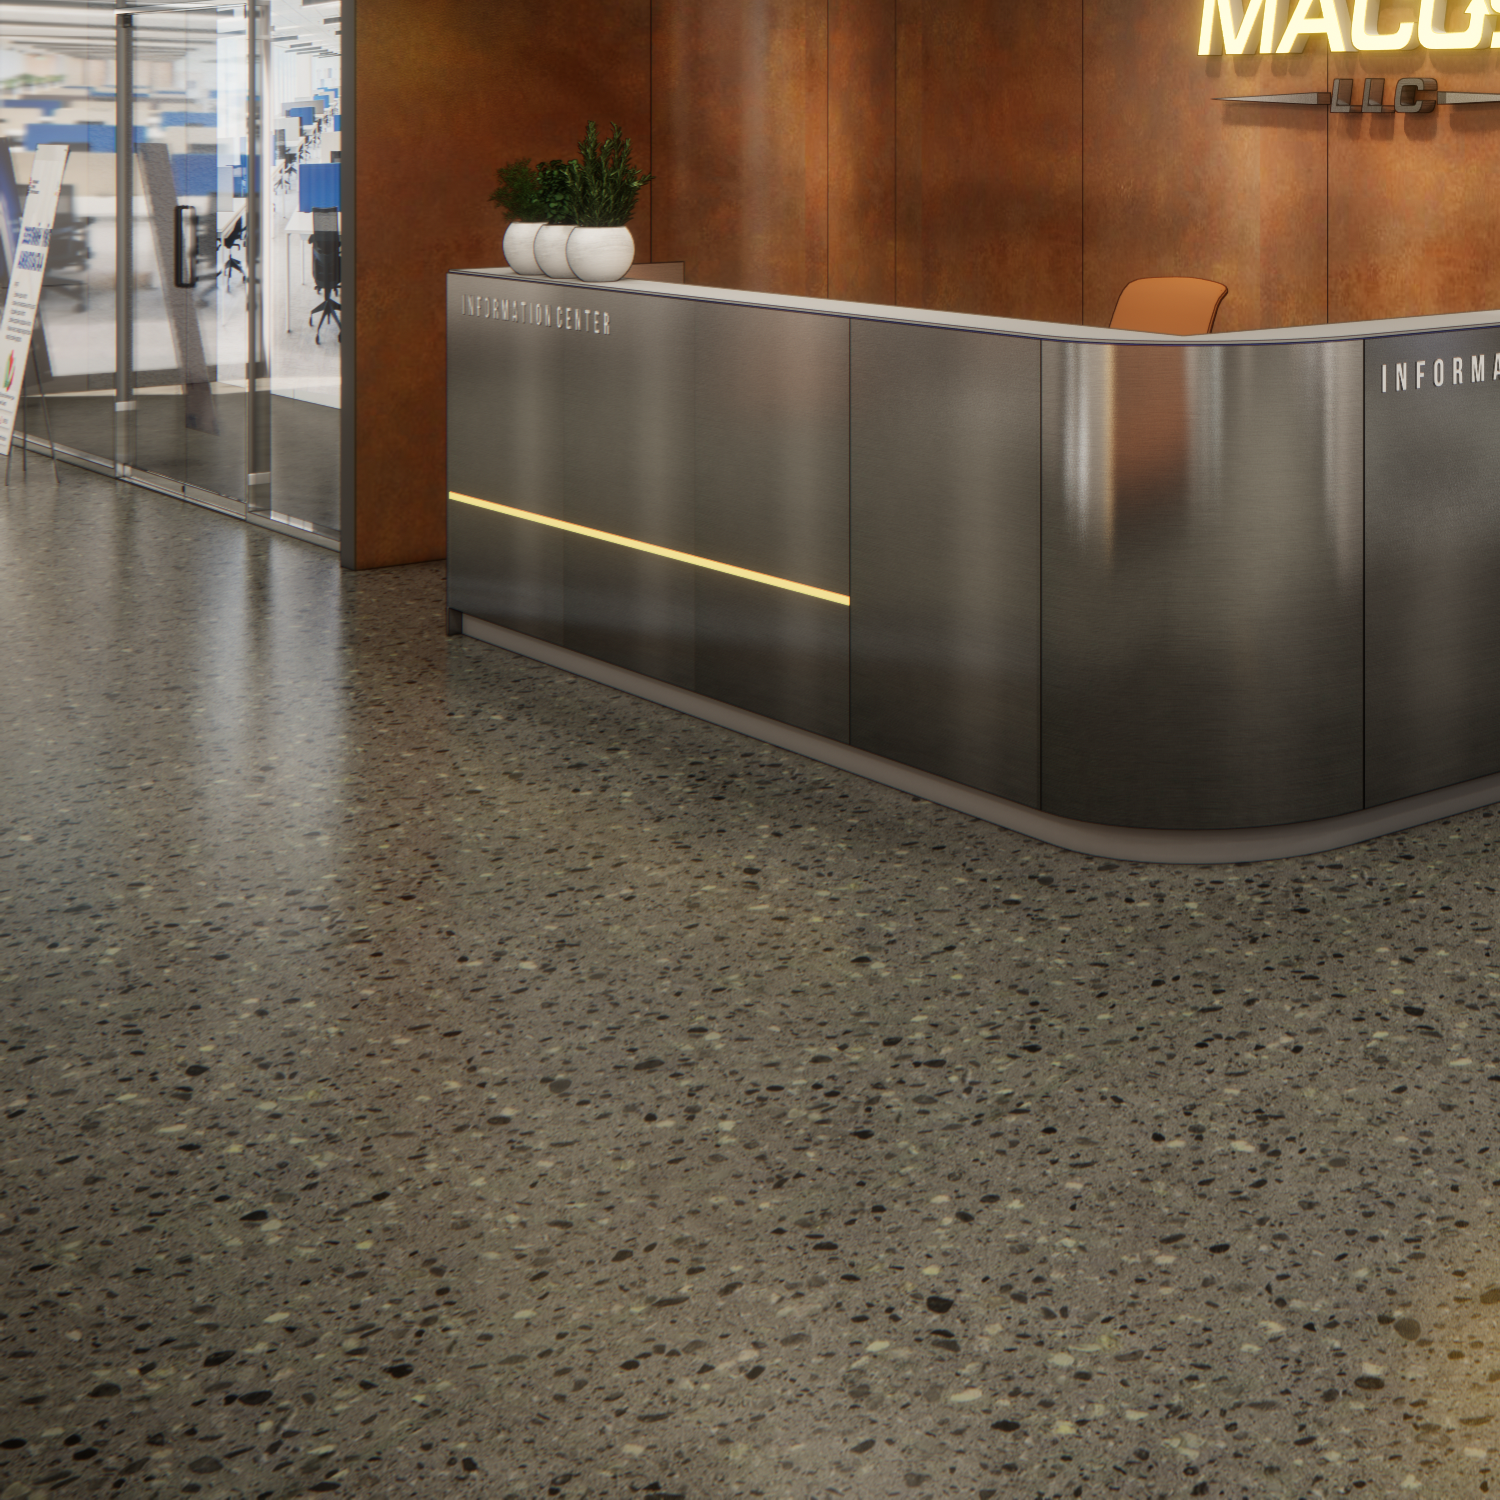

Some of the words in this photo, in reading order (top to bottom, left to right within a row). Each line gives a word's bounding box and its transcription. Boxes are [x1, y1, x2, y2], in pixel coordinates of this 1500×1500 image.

[1330, 77, 1438, 113] LLC
[461, 294, 551, 328] INFORMATION
[556, 305, 611, 336] CENTER
